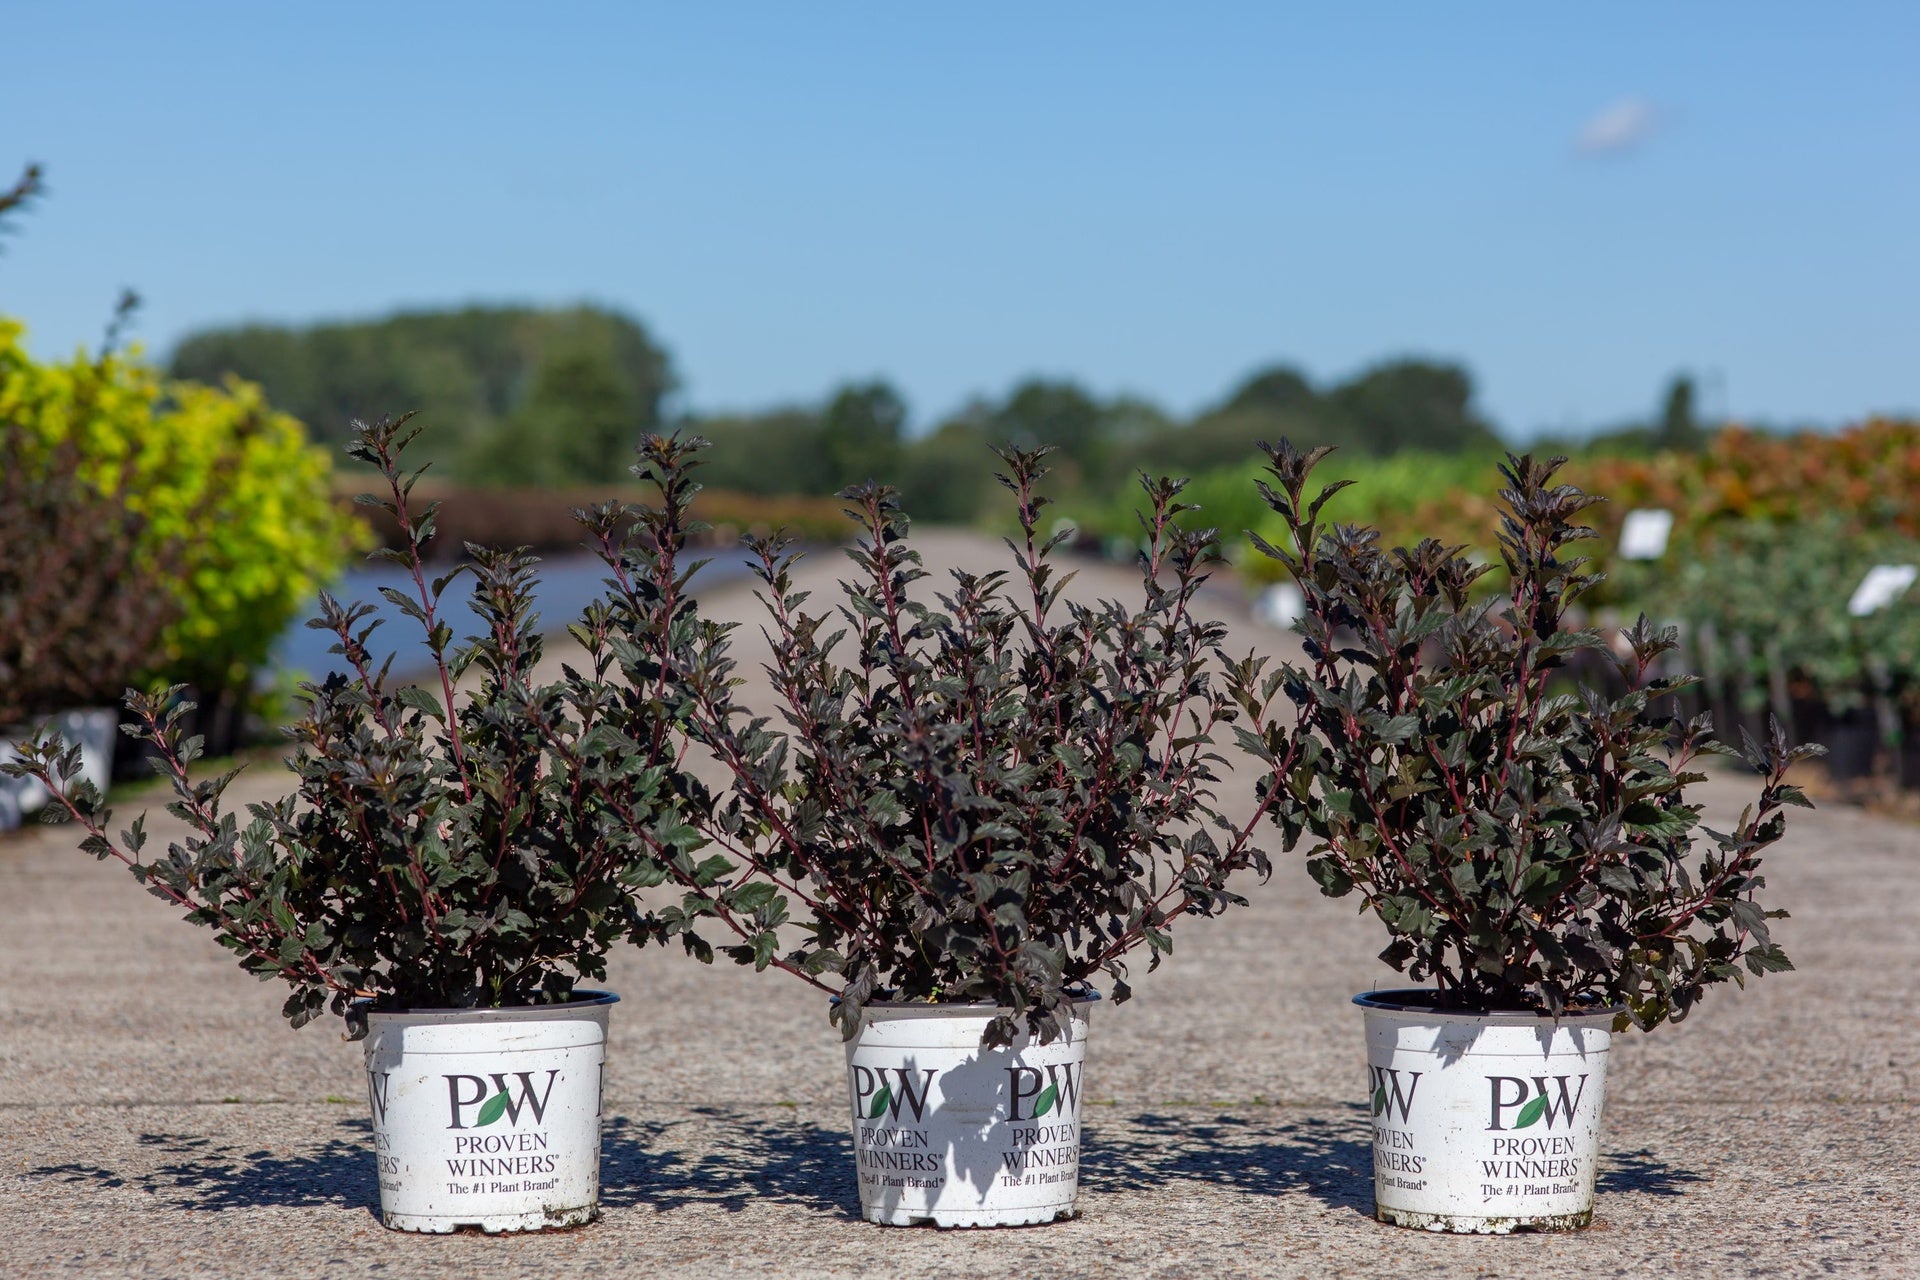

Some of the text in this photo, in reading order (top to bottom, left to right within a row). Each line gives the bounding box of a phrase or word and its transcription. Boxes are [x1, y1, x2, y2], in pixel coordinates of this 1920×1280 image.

[441, 1069, 561, 1129] PW
[852, 1065, 939, 1123] PW
[1003, 1061, 1083, 1122] PW
[1484, 1074, 1589, 1131] PW
[455, 1132, 548, 1154] PROVEN
[861, 1126, 929, 1148] PROVEN
[1012, 1123, 1076, 1147] PROVEN
[1493, 1136, 1576, 1156] PROVEN
[447, 1183, 469, 1194] The
[472, 1182, 485, 1193] #1
[490, 1181, 519, 1193] Plant
[882, 1174, 905, 1188] Plant
[1001, 1176, 1022, 1186] The
[1025, 1174, 1035, 1185] #1
[1039, 1173, 1059, 1184] Plant
[1481, 1184, 1503, 1195] The
[1506, 1184, 1519, 1195] #1
[1524, 1184, 1550, 1195] Plant
